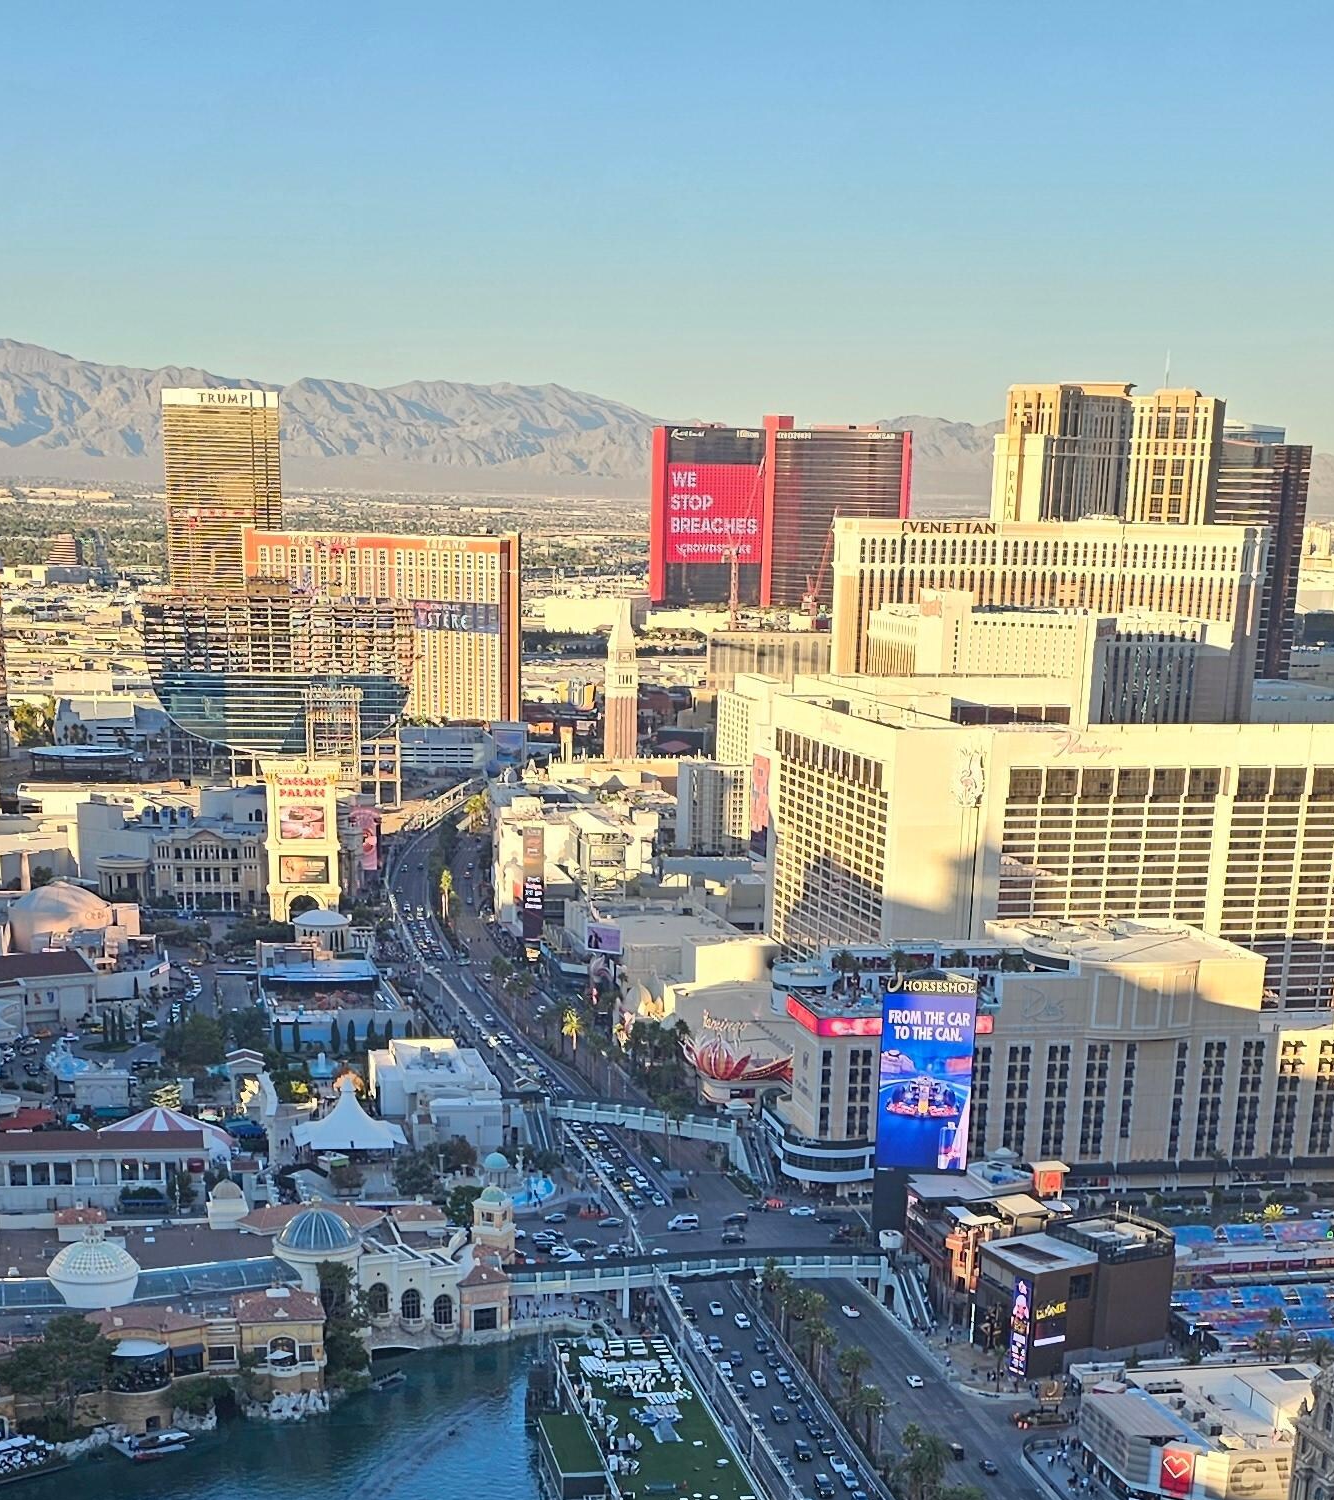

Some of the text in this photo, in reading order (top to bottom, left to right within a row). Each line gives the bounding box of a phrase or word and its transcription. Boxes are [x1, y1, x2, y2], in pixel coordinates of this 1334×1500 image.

[197, 393, 247, 404] TRUMP
[671, 471, 697, 488] WE
[670, 494, 714, 511] STOP
[670, 517, 757, 534] BREACHES
[909, 522, 996, 535] VENETIAN
[426, 538, 467, 550] ISLAND
[277, 777, 328, 787] CAESARS
[279, 788, 326, 798] PALACE
[903, 980, 976, 994] HORSESHOE
[888, 1009, 971, 1027] FROM THE CAR
[894, 1026, 910, 1040] TO
[913, 1026, 933, 1041] THE
